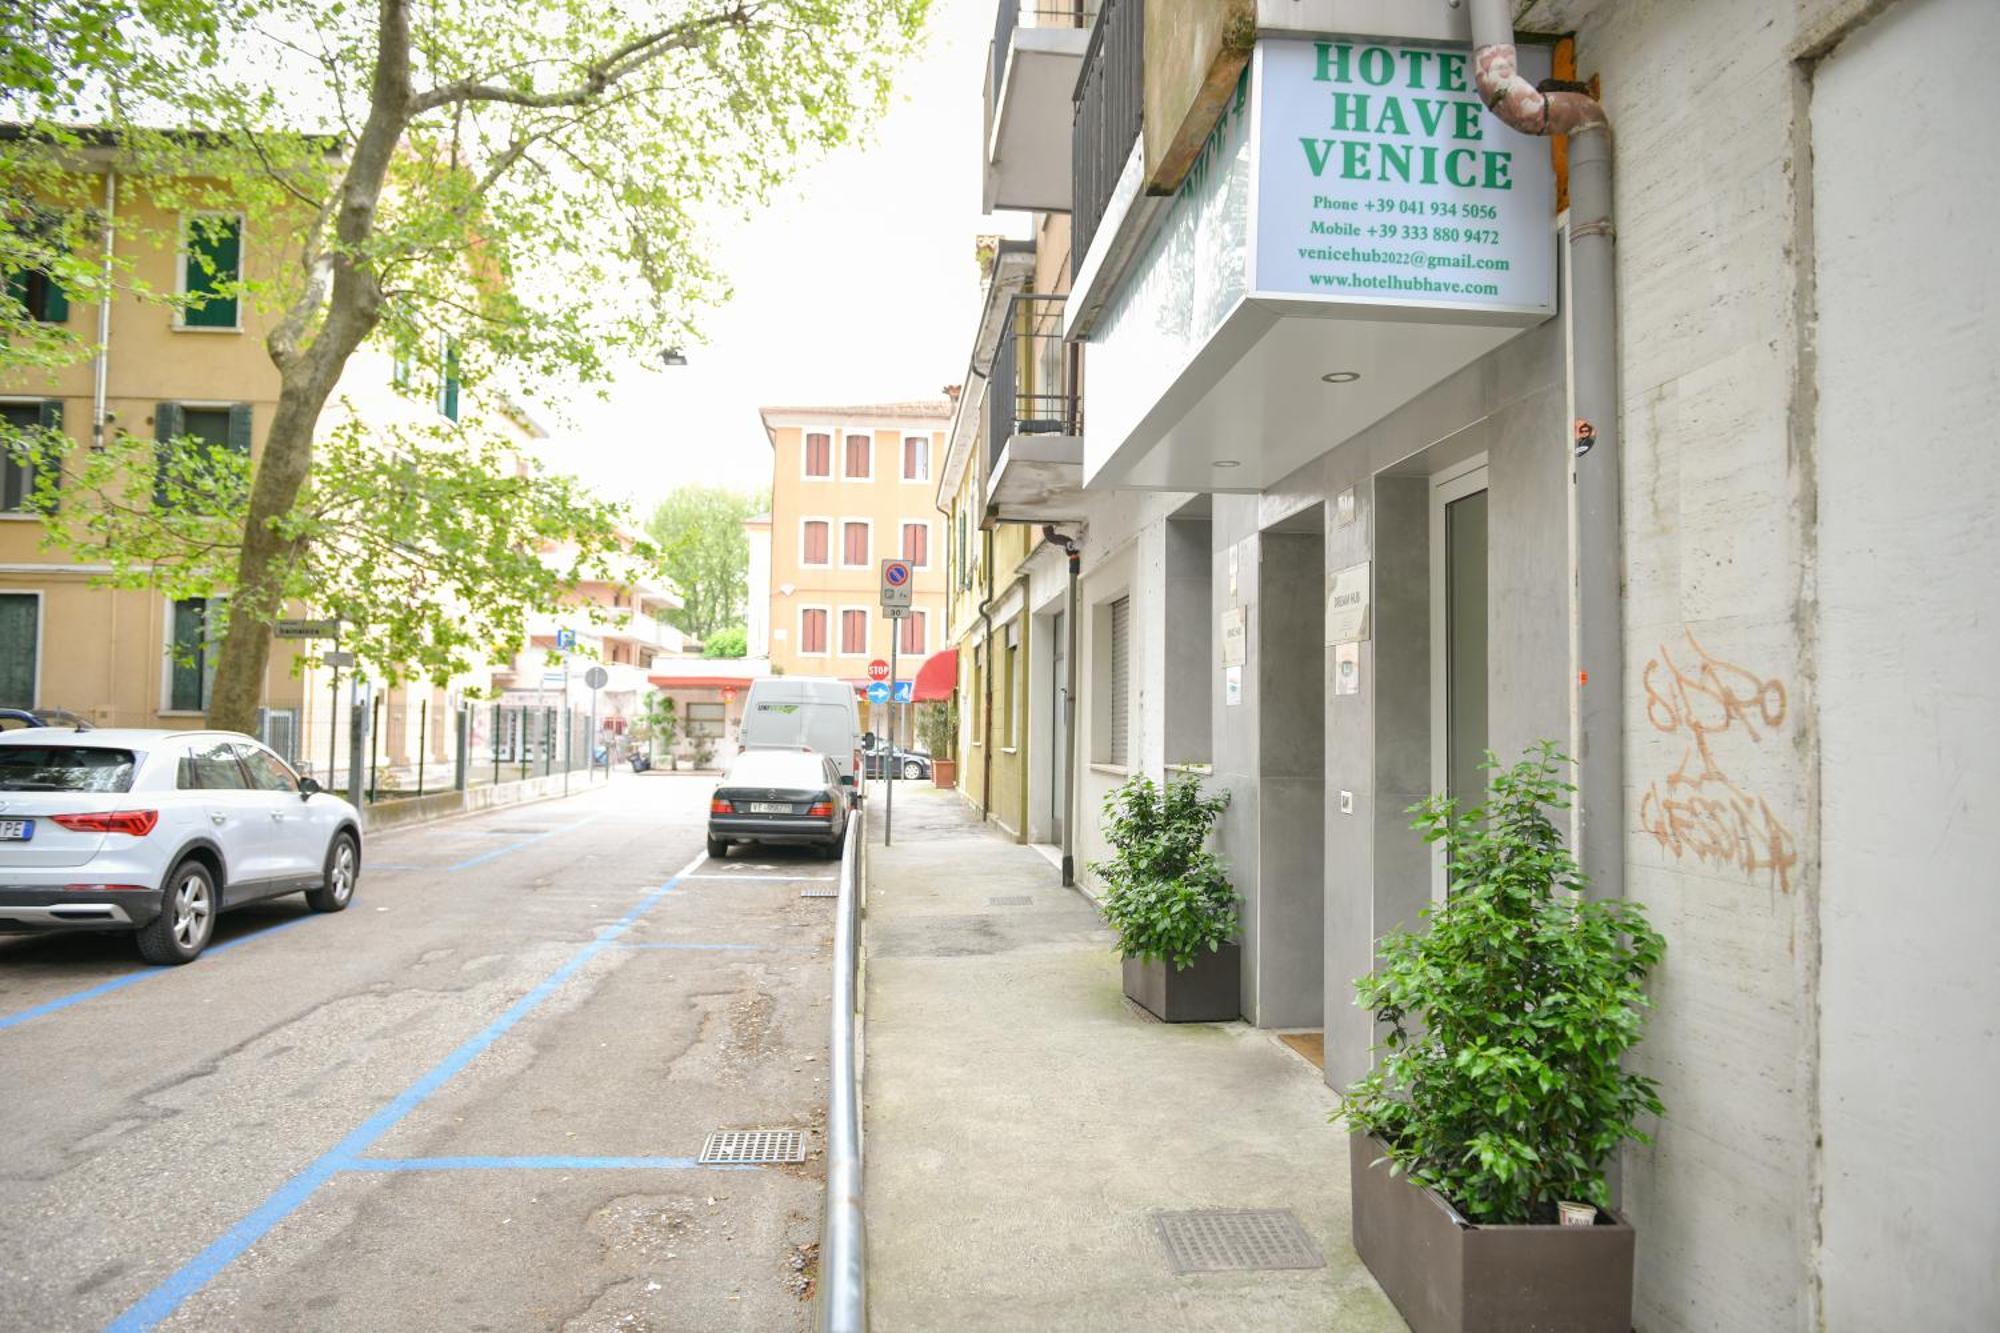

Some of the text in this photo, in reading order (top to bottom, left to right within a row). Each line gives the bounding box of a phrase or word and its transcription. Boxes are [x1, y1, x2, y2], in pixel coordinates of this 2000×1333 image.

[1313, 42, 1478, 94] HOTE
[1331, 92, 1483, 141] HAVE
[1299, 137, 1513, 191] VENICE
[1313, 195, 1498, 220] Phone +39 041 934 5056
[1310, 220, 1500, 246] Mobile +39 333 880 9472
[1298, 245, 1511, 272] venicehub2022@gmail.com
[1309, 272, 1499, 297] www.hotelhubhave.com
[868, 665, 890, 675] STOP
